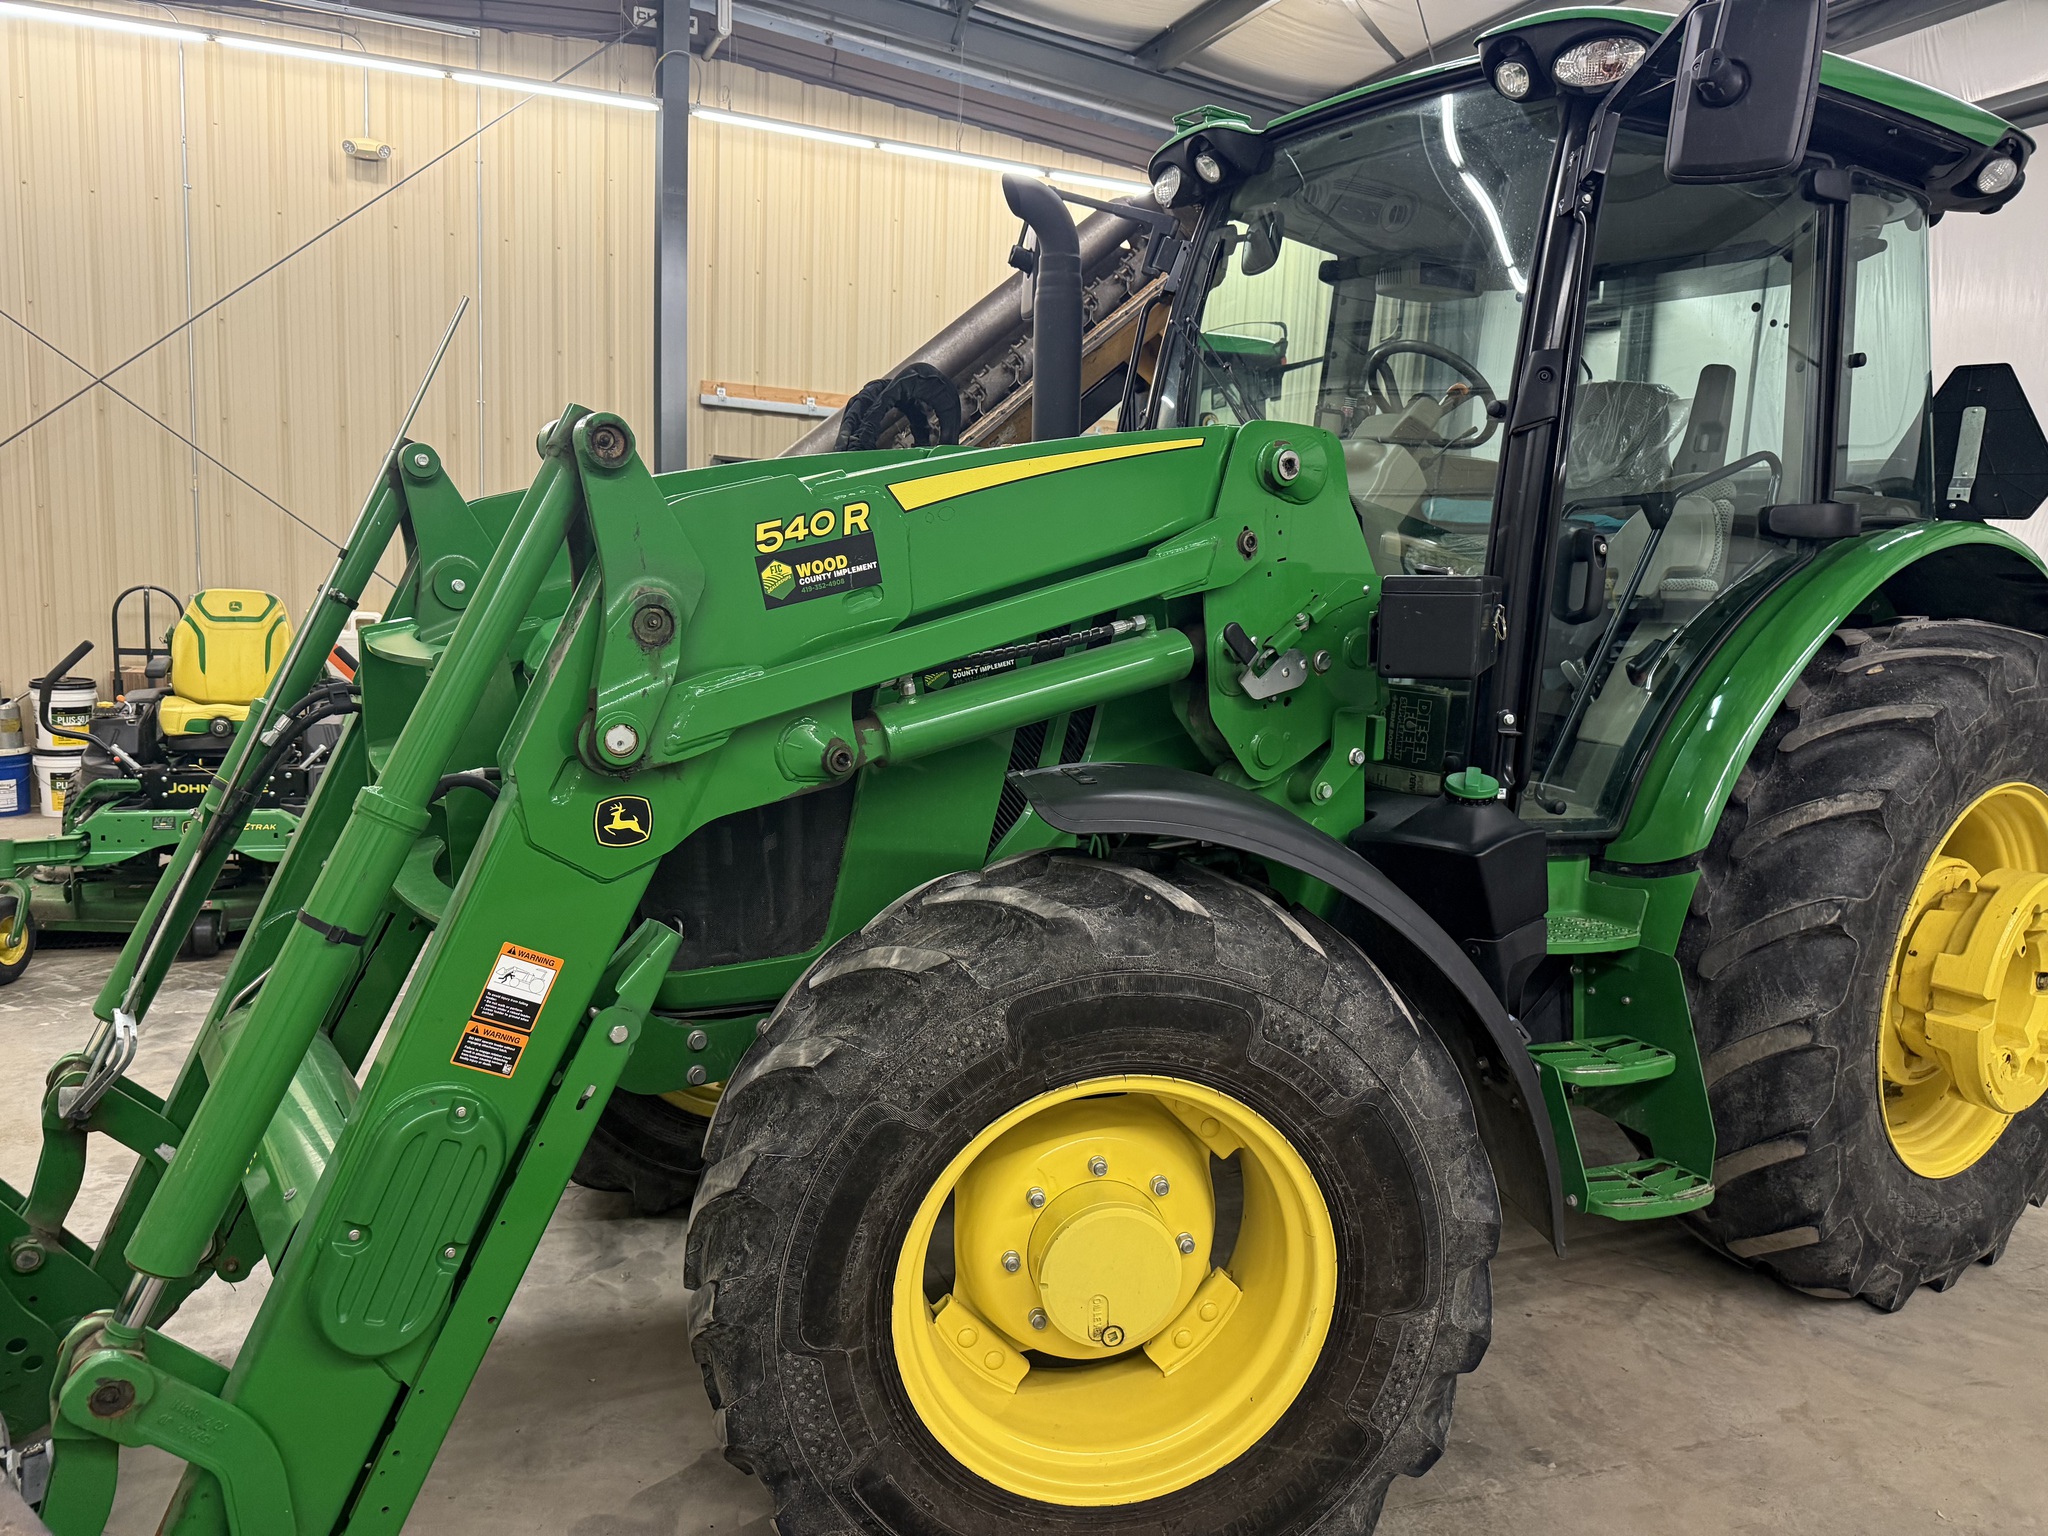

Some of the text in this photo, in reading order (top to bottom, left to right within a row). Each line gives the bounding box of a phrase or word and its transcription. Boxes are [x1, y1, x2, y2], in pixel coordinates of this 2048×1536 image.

[755, 501, 870, 554] 540 R
[770, 564, 782, 574] FIC
[796, 555, 848, 577] WOOD
[799, 561, 877, 585] COUNTY IMPLEMENT
[952, 666, 978, 679] COUNTY
[980, 659, 1014, 672] IMPLEMENT
[1394, 696, 1408, 761] SUPPLEMENT
[1402, 705, 1418, 752] FUEL
[1412, 699, 1432, 763] DIESEL
[168, 782, 211, 794] JOHN
[518, 950, 555, 966] WARNING
[483, 1028, 520, 1044] WARNING
